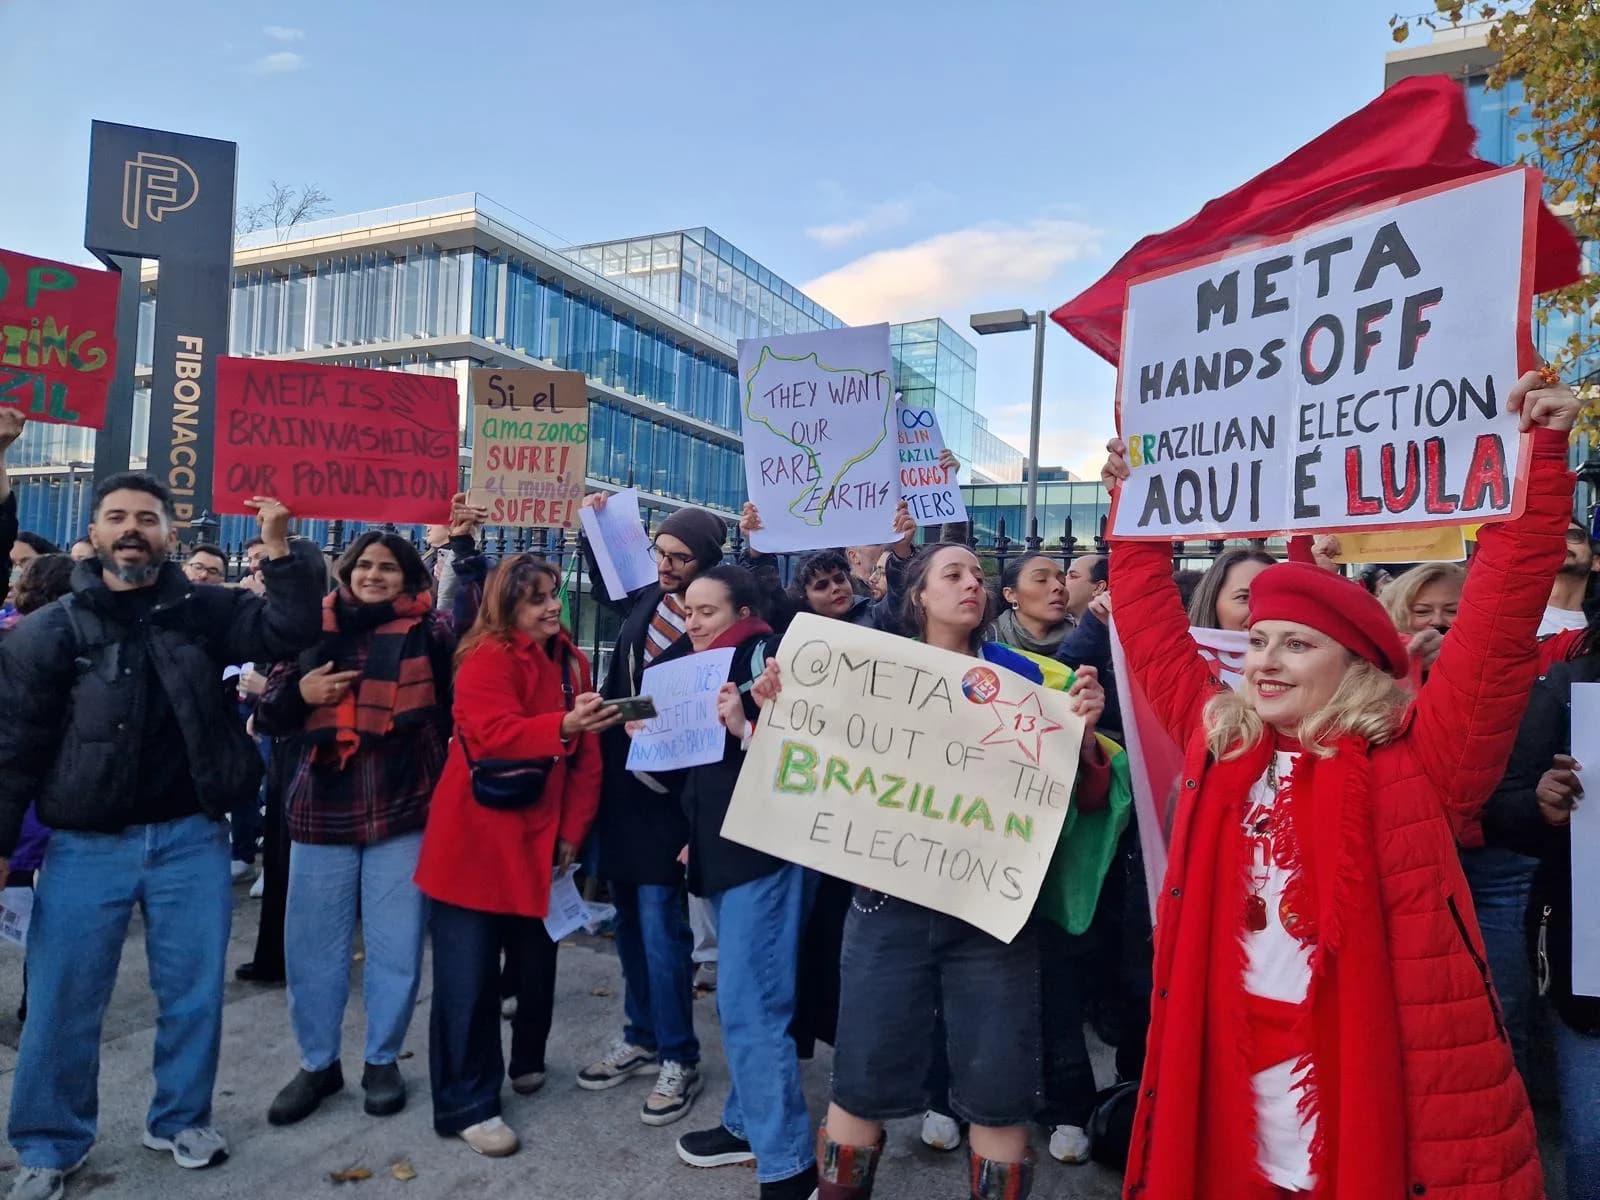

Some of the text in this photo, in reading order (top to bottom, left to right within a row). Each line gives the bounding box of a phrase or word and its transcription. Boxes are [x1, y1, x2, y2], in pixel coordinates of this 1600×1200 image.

[1196, 220, 1421, 334] META
[1139, 287, 1444, 404] HANDS OFF
[241, 371, 384, 411] META IS
[487, 374, 564, 414] Si el
[763, 370, 886, 409] THEY WANT
[168, 334, 203, 496] FIBONACCI
[226, 408, 450, 459] BRAINWASHING
[482, 416, 588, 445] amazonas
[791, 418, 832, 445] OUR
[1129, 374, 1498, 468] BRAZILIAN ELECTION
[226, 460, 448, 501] OUR POPULATION
[486, 444, 570, 482] SUFRE!
[760, 452, 822, 486] RARE
[1137, 432, 1512, 528] AQUI É LULA
[490, 498, 573, 528] SUFRE!
[804, 480, 891, 513] EARTHS
[790, 640, 953, 714] @META
[1014, 713, 1036, 732] 13
[767, 699, 1067, 810] LOG OUT OF THE
[773, 739, 1034, 843] BRAZILIAN
[809, 812, 1024, 901] ELECTIONS
